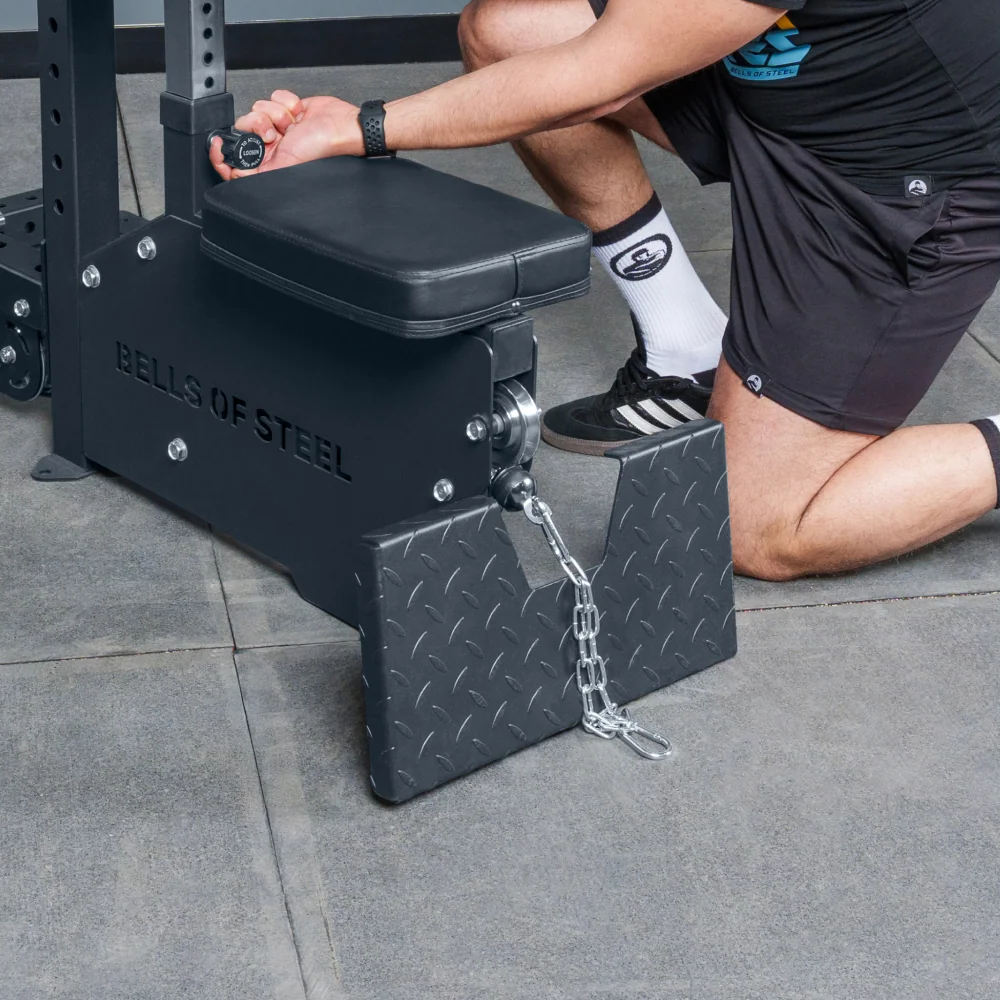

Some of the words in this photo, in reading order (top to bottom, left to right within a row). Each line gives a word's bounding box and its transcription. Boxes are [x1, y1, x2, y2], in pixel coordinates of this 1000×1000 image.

[765, 69, 795, 77] STEEL
[115, 340, 203, 409] BELLS
[209, 387, 247, 429] OF
[253, 408, 353, 484] STEEL
